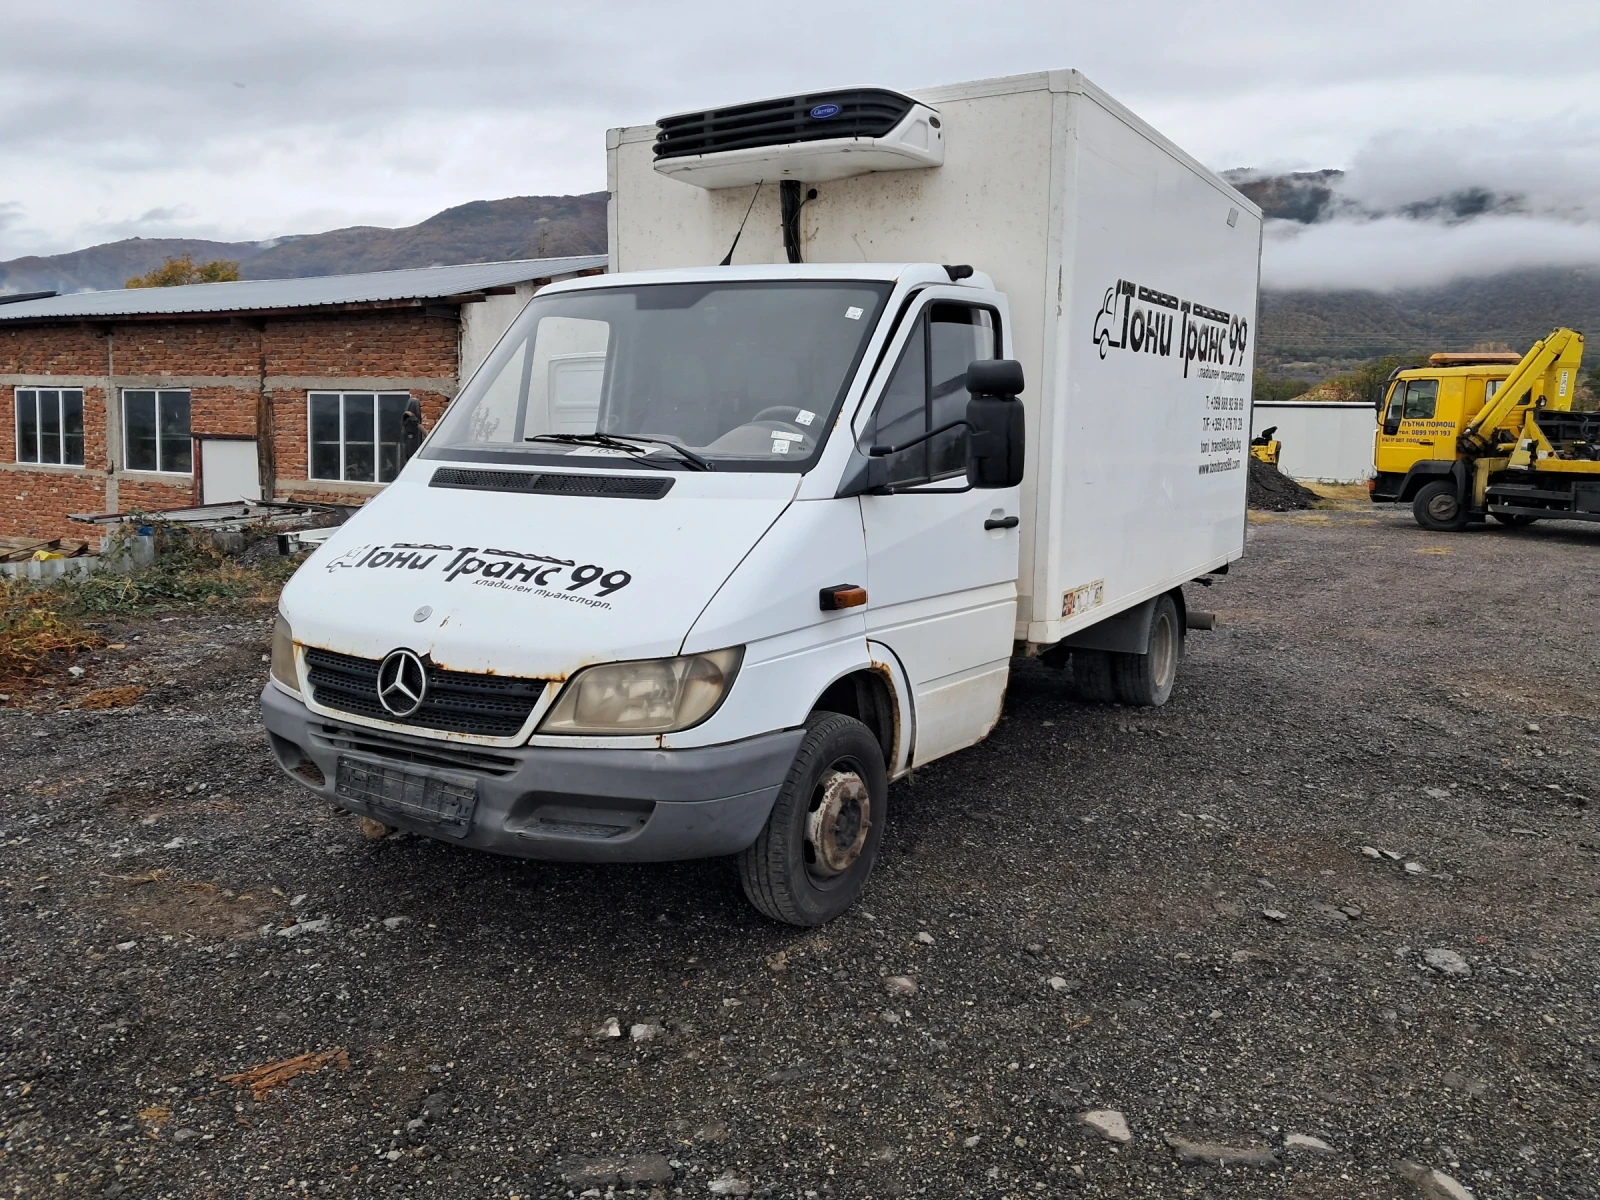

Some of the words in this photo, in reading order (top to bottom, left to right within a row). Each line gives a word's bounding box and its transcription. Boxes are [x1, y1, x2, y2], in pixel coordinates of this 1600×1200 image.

[813, 106, 836, 116] Carrier
[1229, 313, 1248, 367] 99
[1197, 364, 1220, 380] ладилен
[441, 547, 563, 586] Транс
[565, 565, 632, 597] 99
